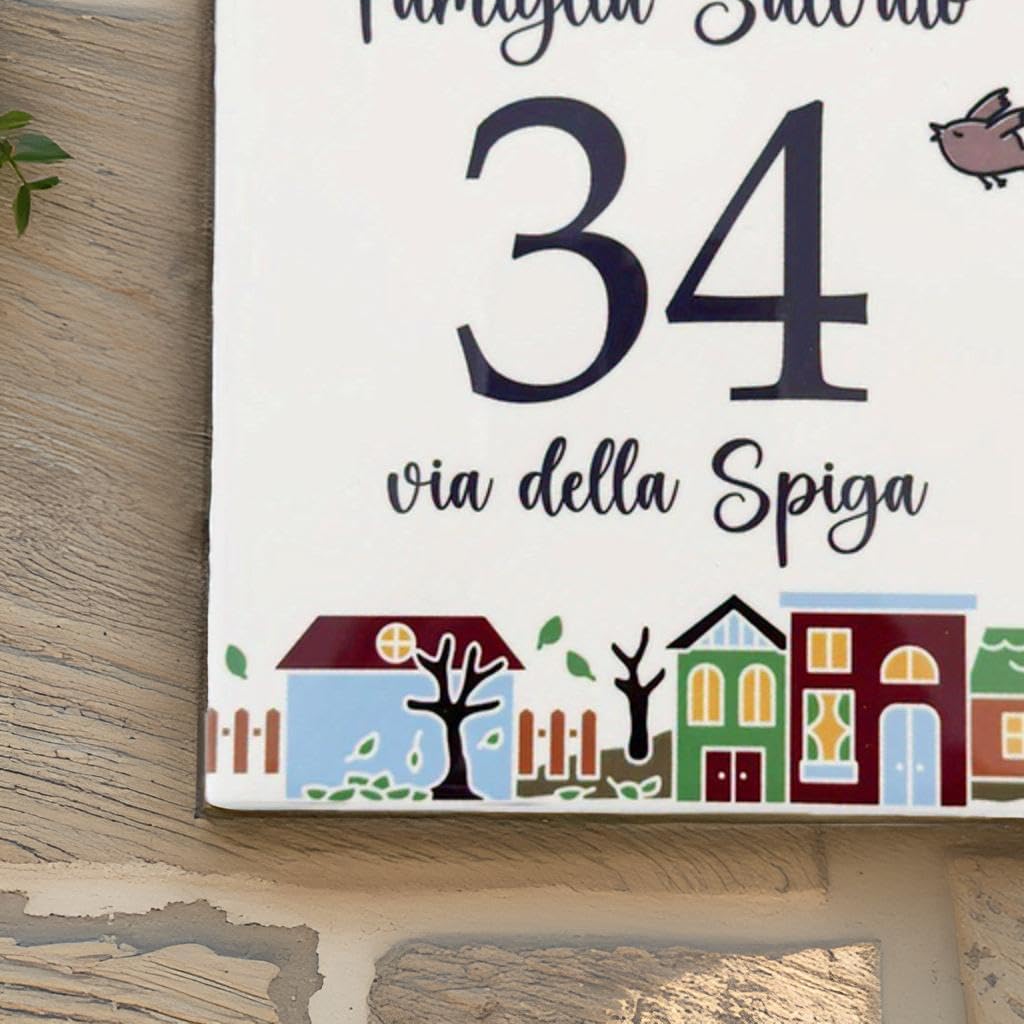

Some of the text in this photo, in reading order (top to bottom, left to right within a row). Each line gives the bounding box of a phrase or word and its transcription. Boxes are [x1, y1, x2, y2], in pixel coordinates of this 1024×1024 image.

[456, 96, 868, 404] 34
[387, 436, 929, 569] via della Spiga
